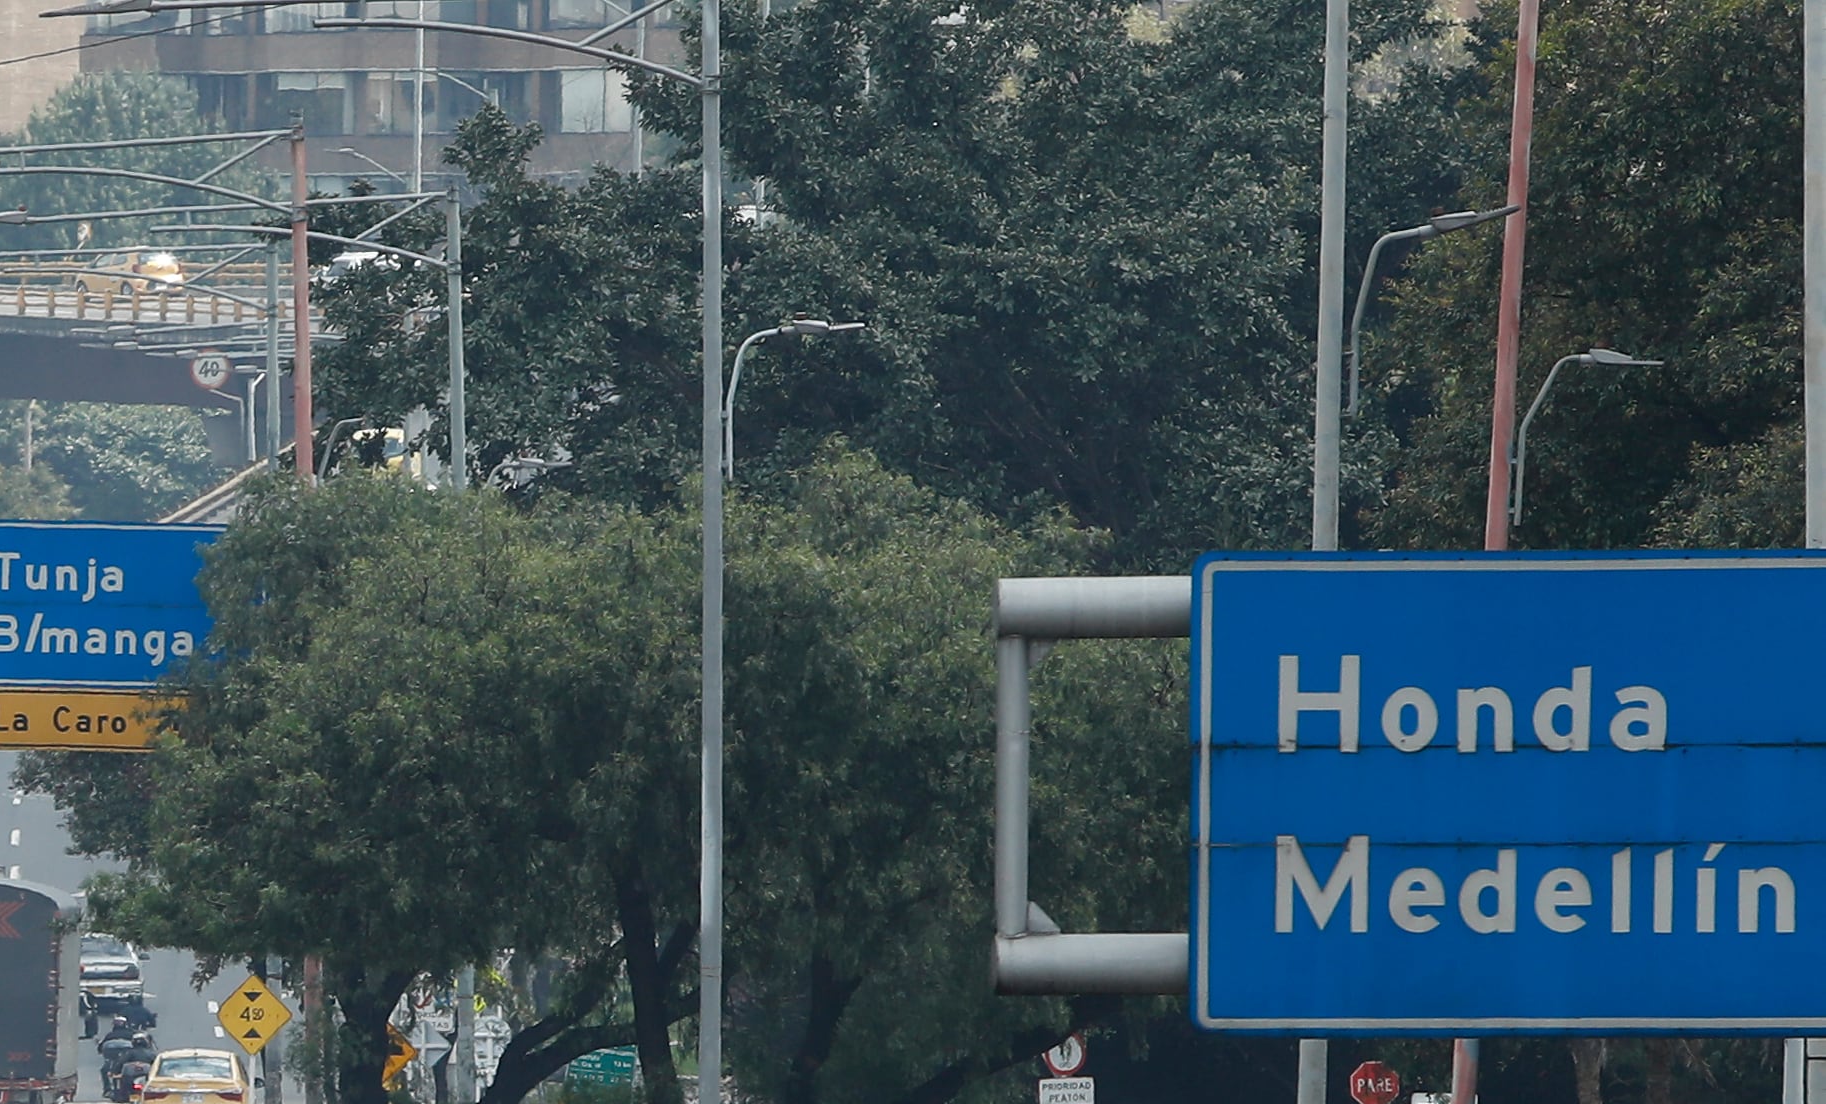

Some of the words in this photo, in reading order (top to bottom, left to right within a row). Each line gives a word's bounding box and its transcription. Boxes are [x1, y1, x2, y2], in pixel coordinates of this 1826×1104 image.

[198, 360, 220, 379] 40
[1278, 653, 1670, 756] Honda
[52, 704, 129, 735] Caro
[1274, 834, 1799, 935] Medellín
[1041, 1081, 1092, 1092] PRIORIDAD
[1357, 1078, 1393, 1093] PARE
[1049, 1092, 1087, 1103] PEATON
